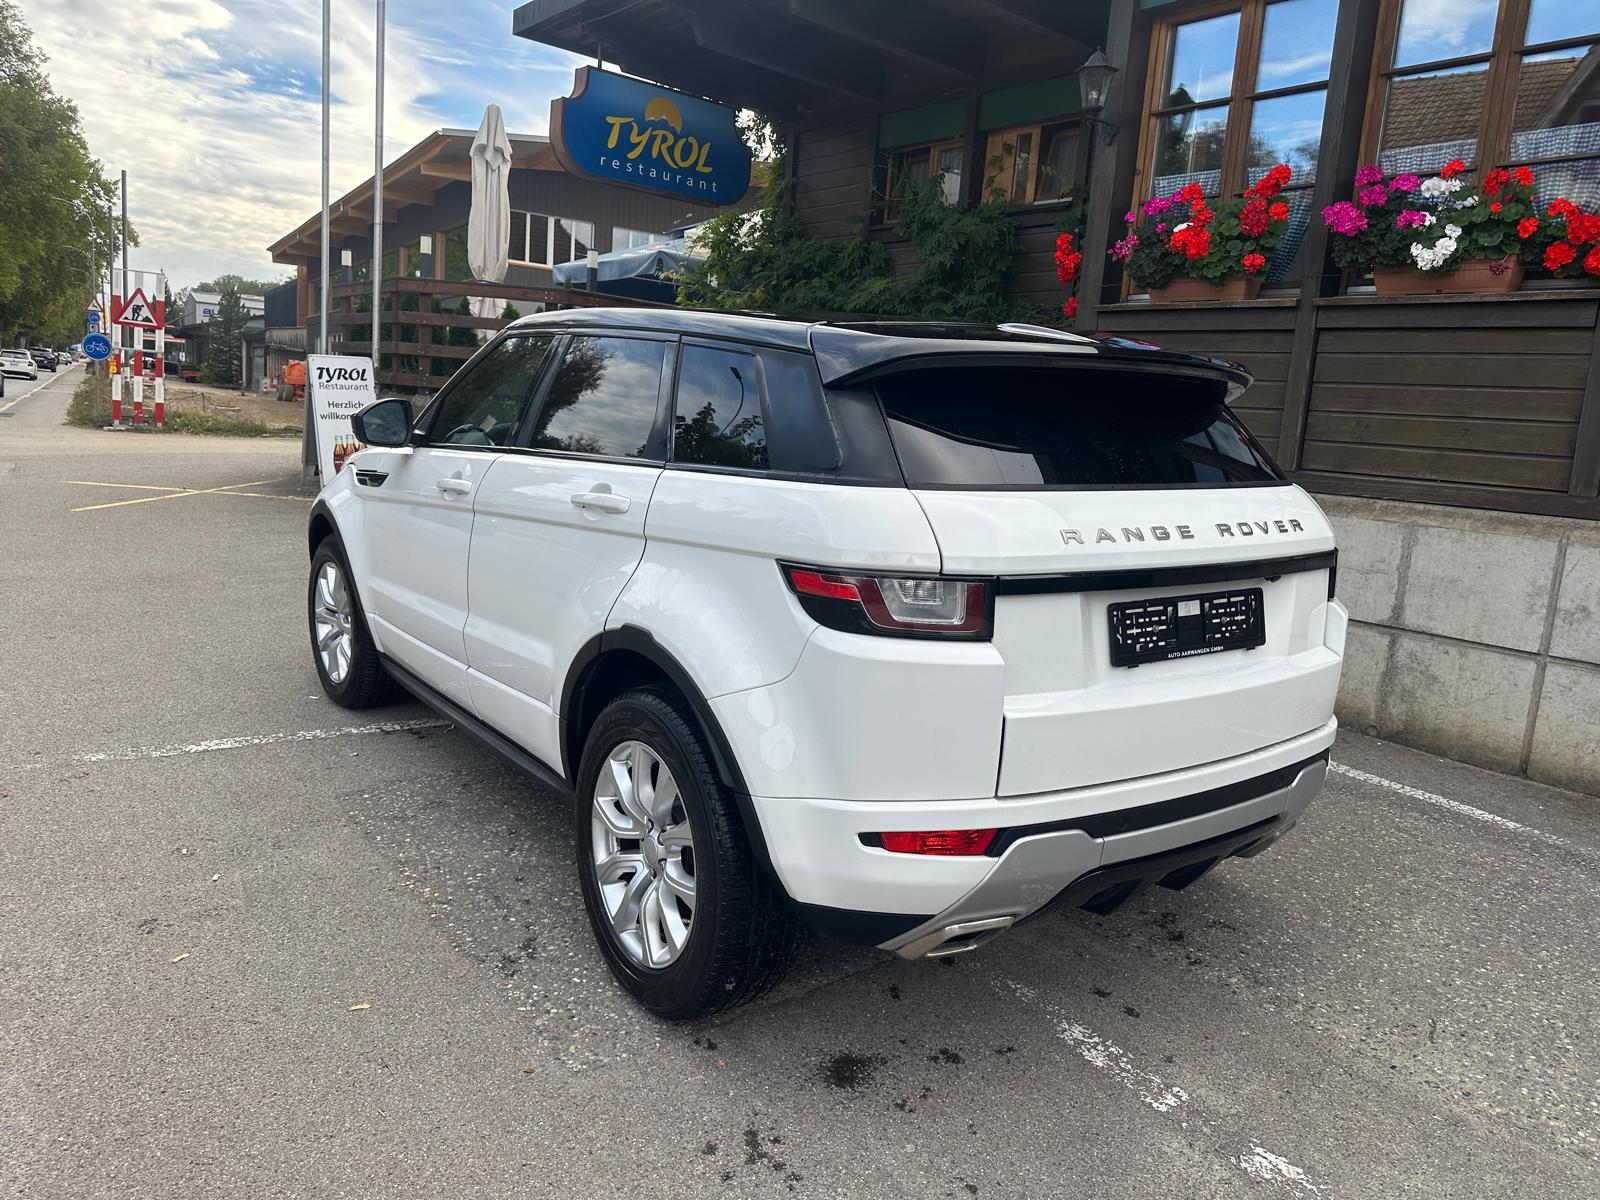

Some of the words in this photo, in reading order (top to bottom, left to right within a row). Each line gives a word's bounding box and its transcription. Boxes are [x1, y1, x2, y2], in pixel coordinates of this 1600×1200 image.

[606, 115, 713, 173] TYROL
[600, 156, 718, 192] restaurant
[316, 366, 368, 383] TYROL
[319, 381, 369, 391] Restaurant
[327, 400, 364, 409] Herzlich
[320, 412, 351, 420] willko
[1059, 525, 1195, 545] RANGE
[1214, 518, 1304, 538] ROVER
[1167, 651, 1181, 659] AUTO
[1181, 647, 1210, 657] AARWANGEN
